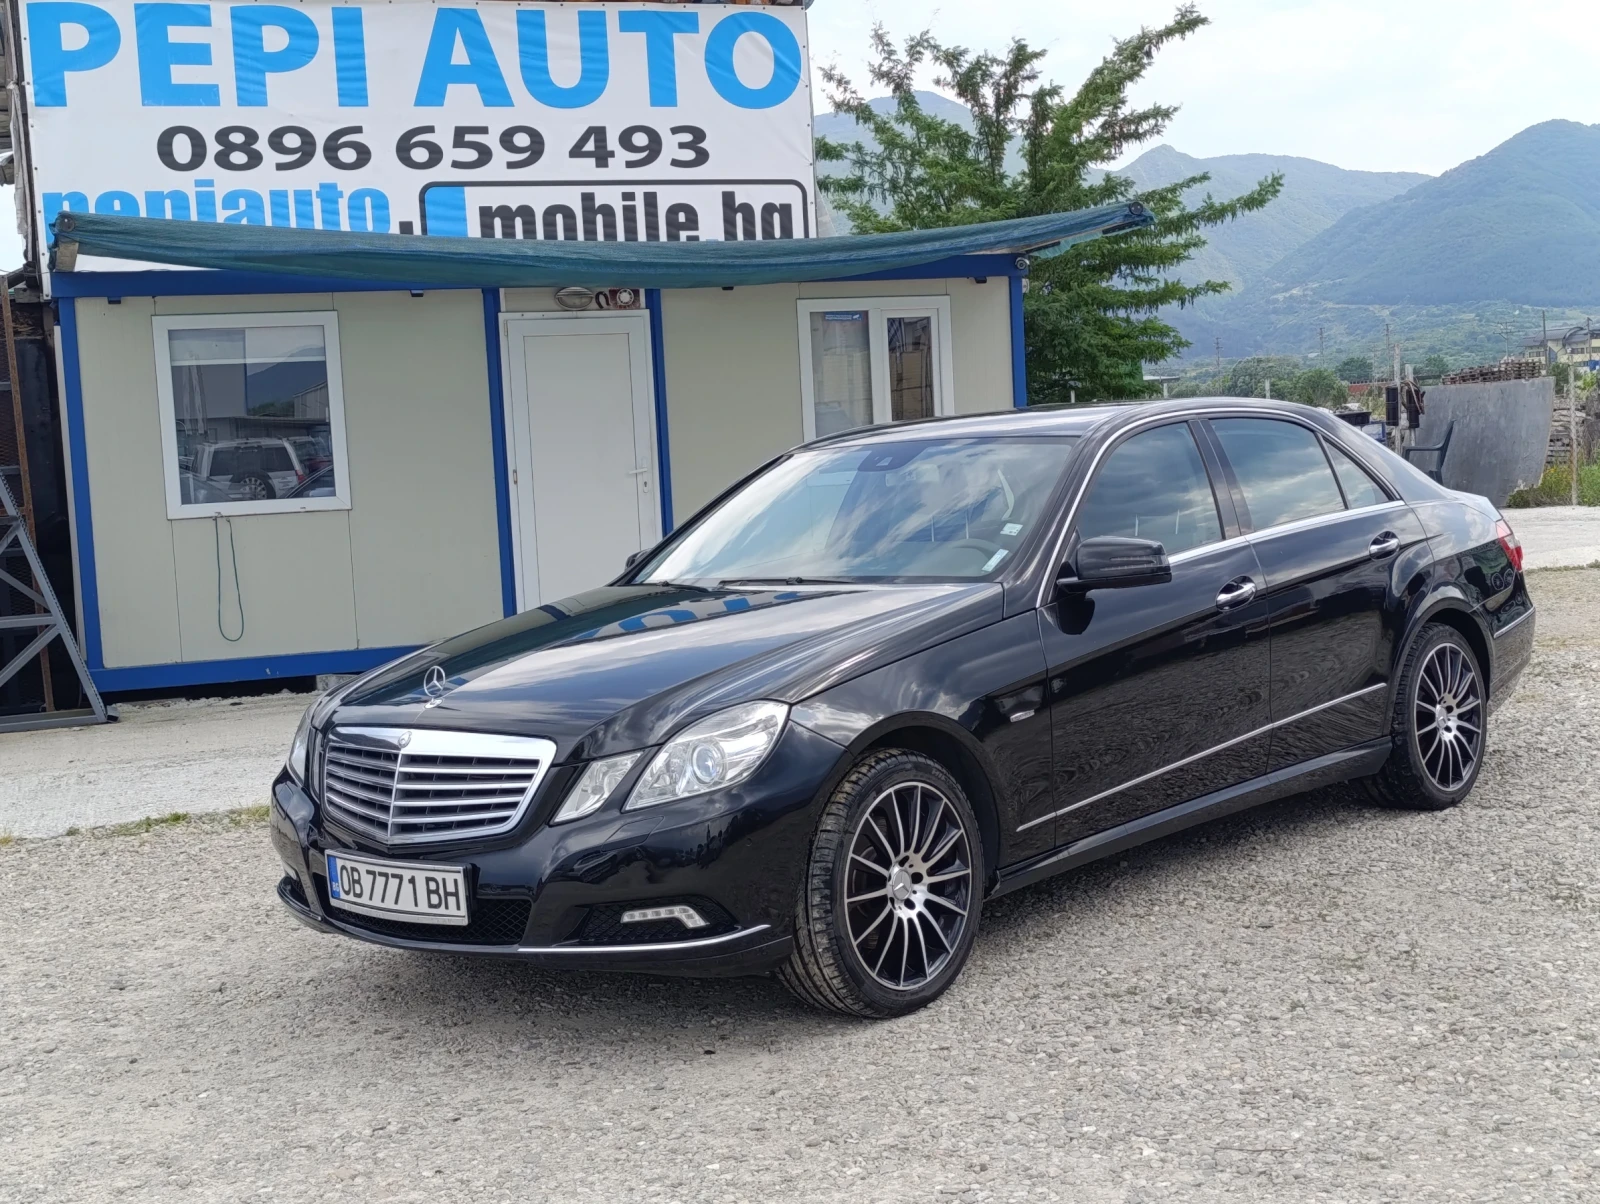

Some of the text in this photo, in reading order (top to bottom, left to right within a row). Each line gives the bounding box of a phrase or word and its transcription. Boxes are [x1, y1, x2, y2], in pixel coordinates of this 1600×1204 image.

[26, 1, 802, 109] PEPI AUTO
[157, 125, 711, 172] 0896 659 493
[340, 864, 461, 911] OB 7771 BH
